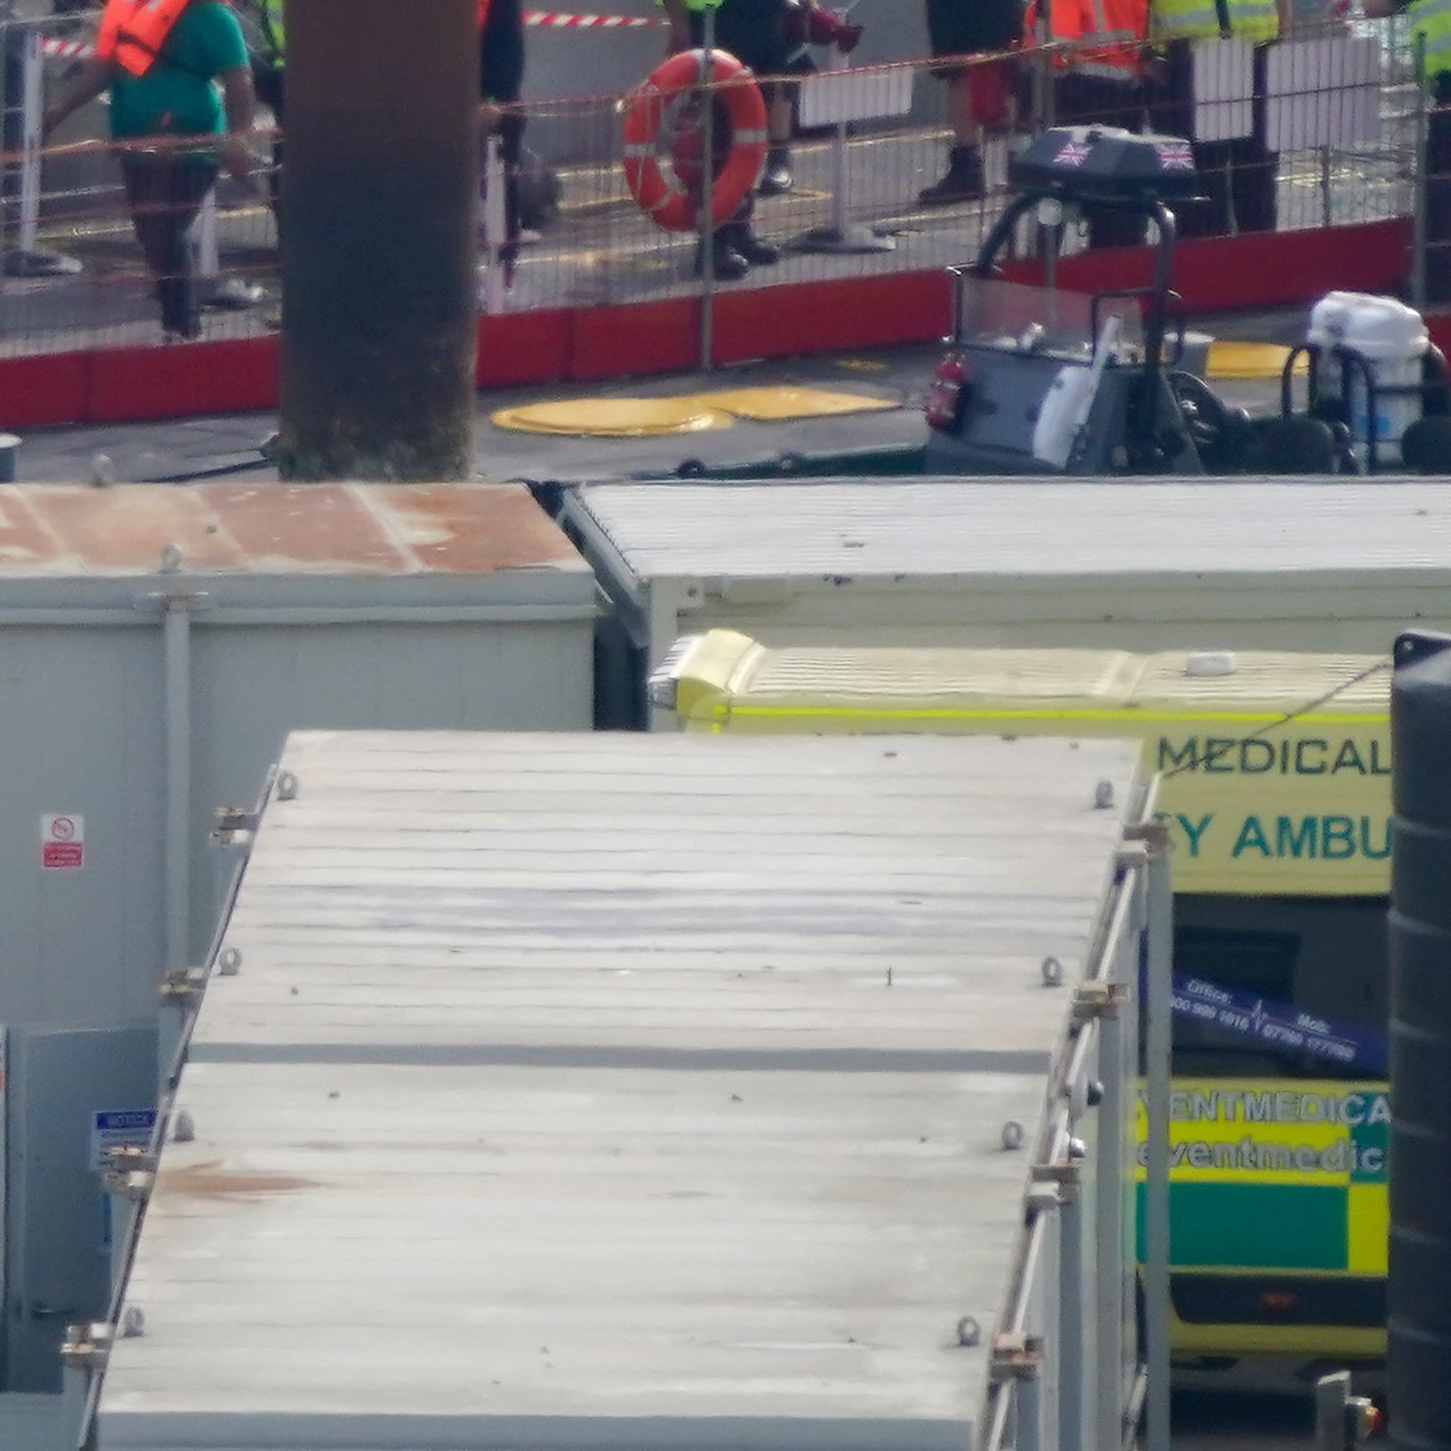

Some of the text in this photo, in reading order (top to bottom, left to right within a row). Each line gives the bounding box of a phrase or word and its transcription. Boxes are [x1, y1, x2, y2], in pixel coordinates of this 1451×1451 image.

[1158, 737, 1393, 775] MEDICAL
[1152, 812, 1393, 860] Y AMBU
